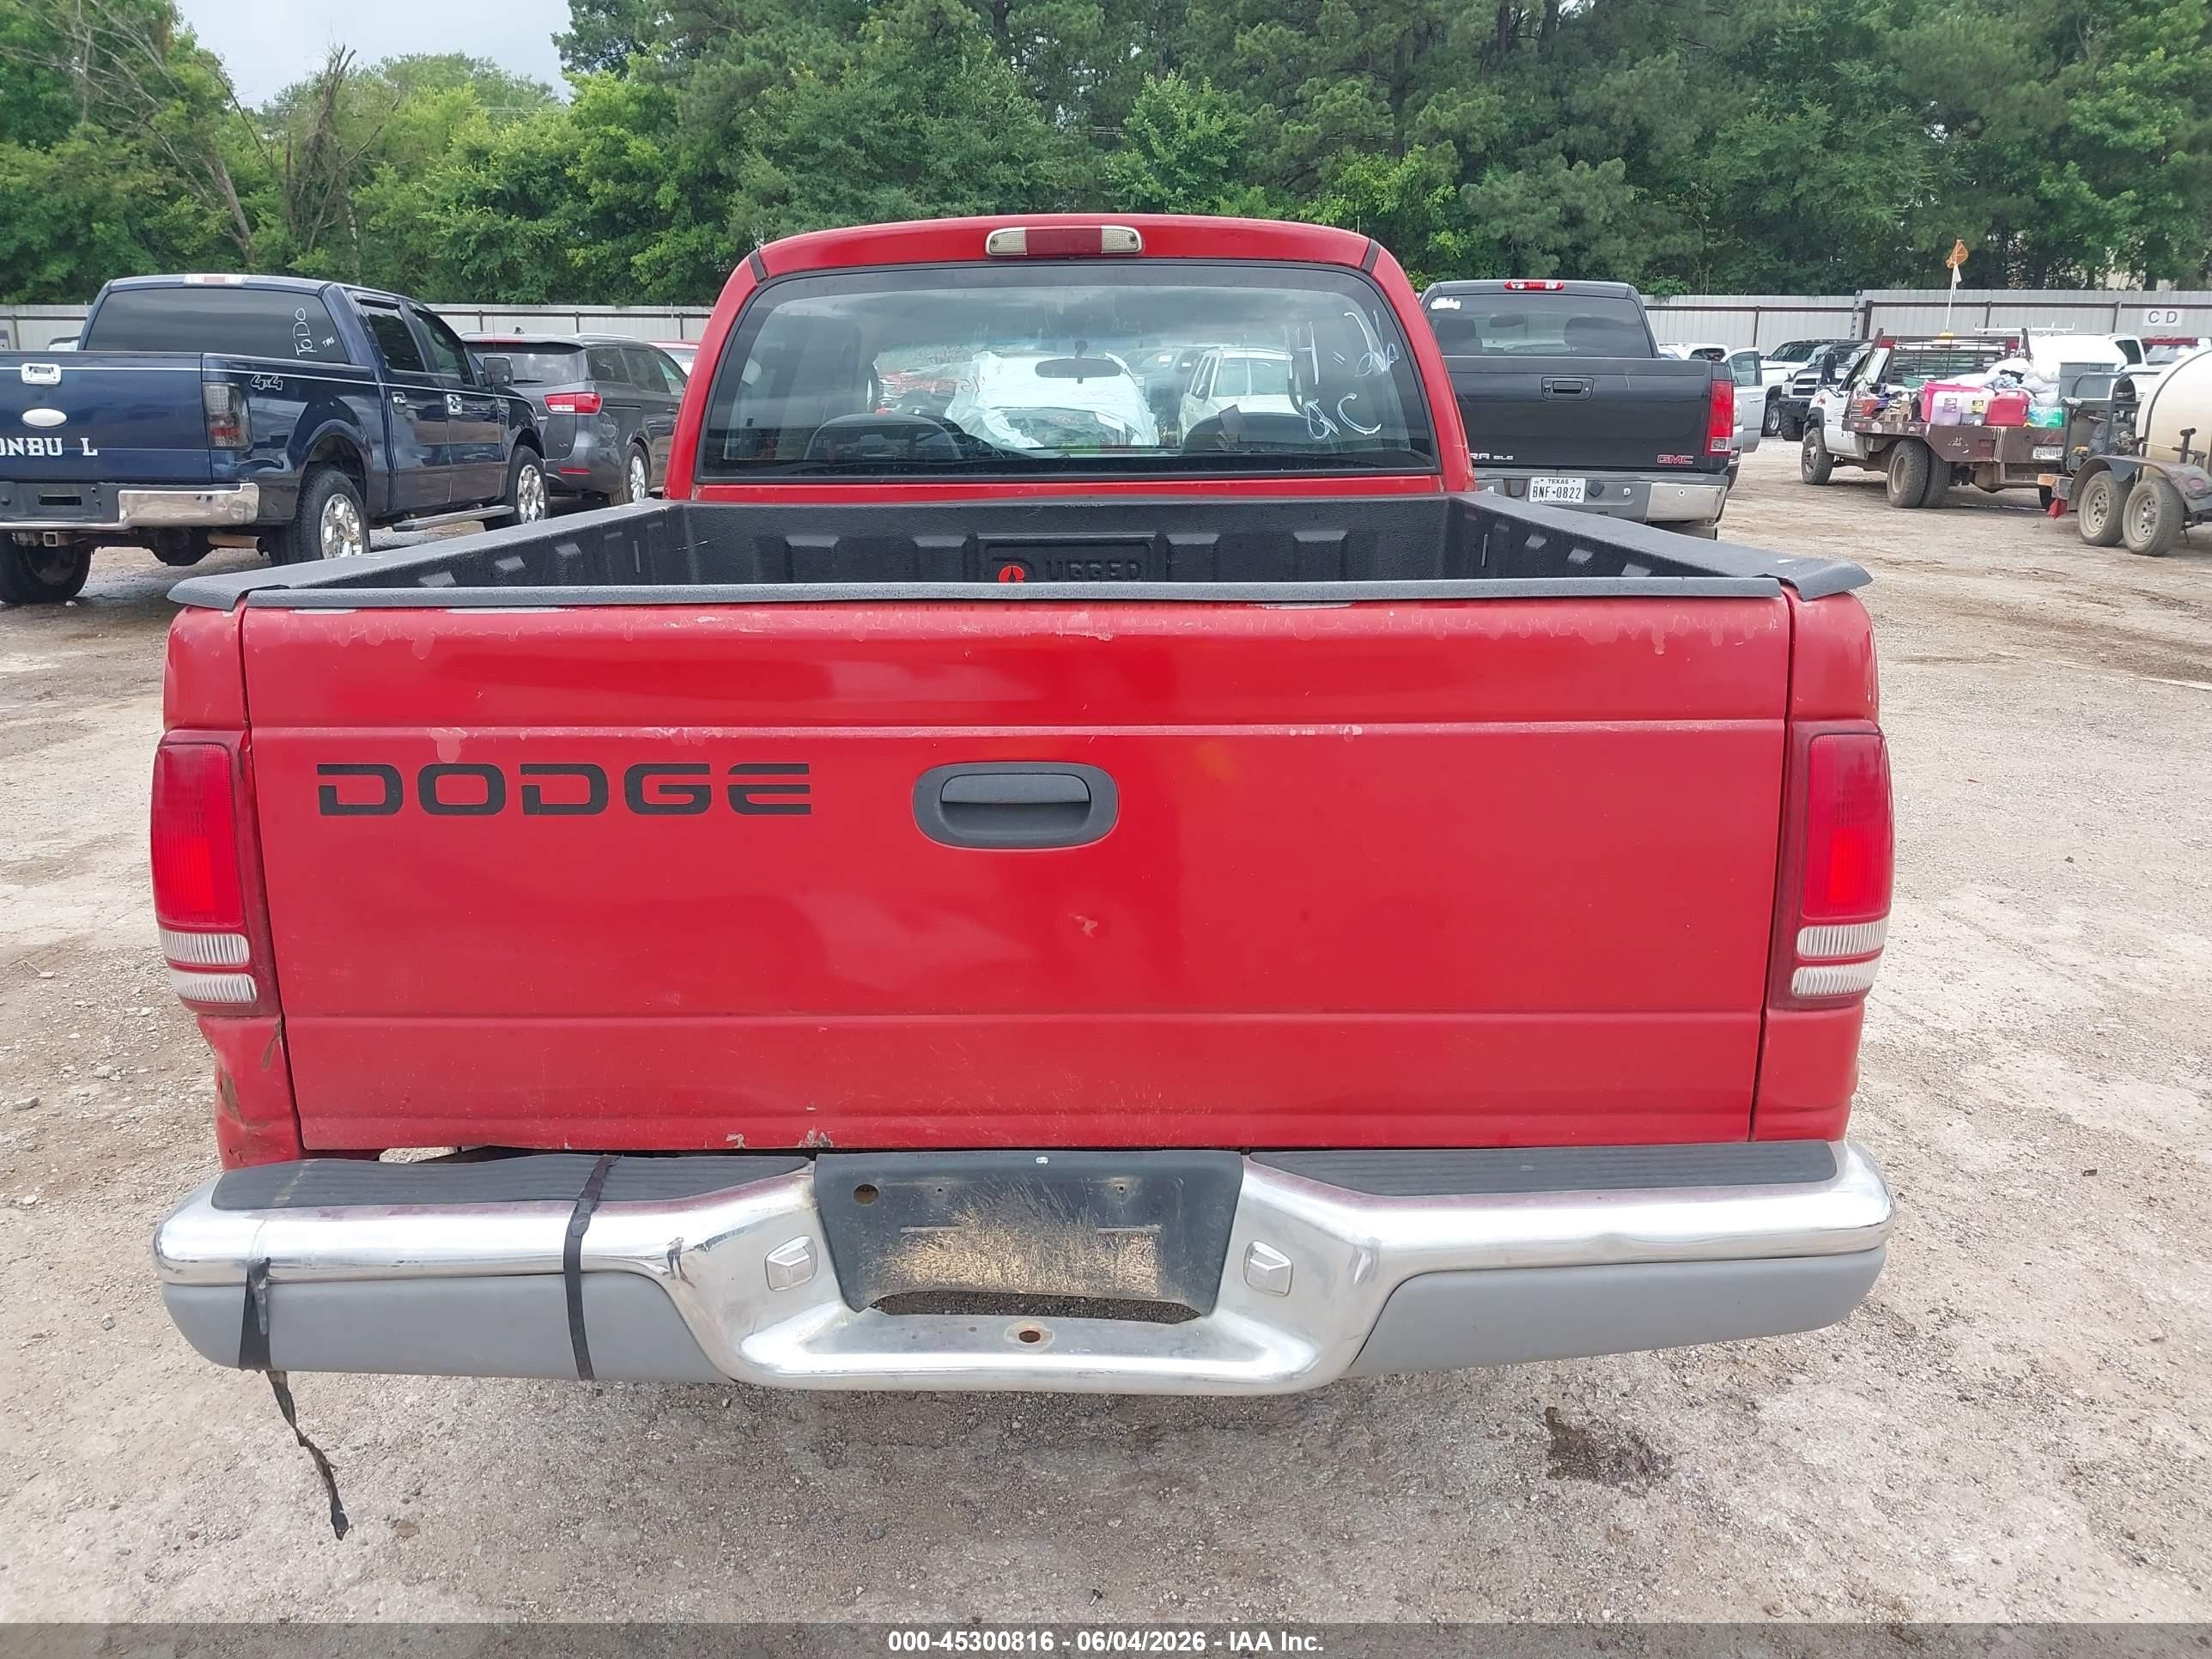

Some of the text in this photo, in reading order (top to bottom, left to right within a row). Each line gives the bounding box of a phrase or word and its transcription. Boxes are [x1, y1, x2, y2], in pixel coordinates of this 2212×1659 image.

[250, 374, 283, 391] 4x4
[1657, 454, 1693, 465] GMC
[317, 763, 812, 815] DODGE
